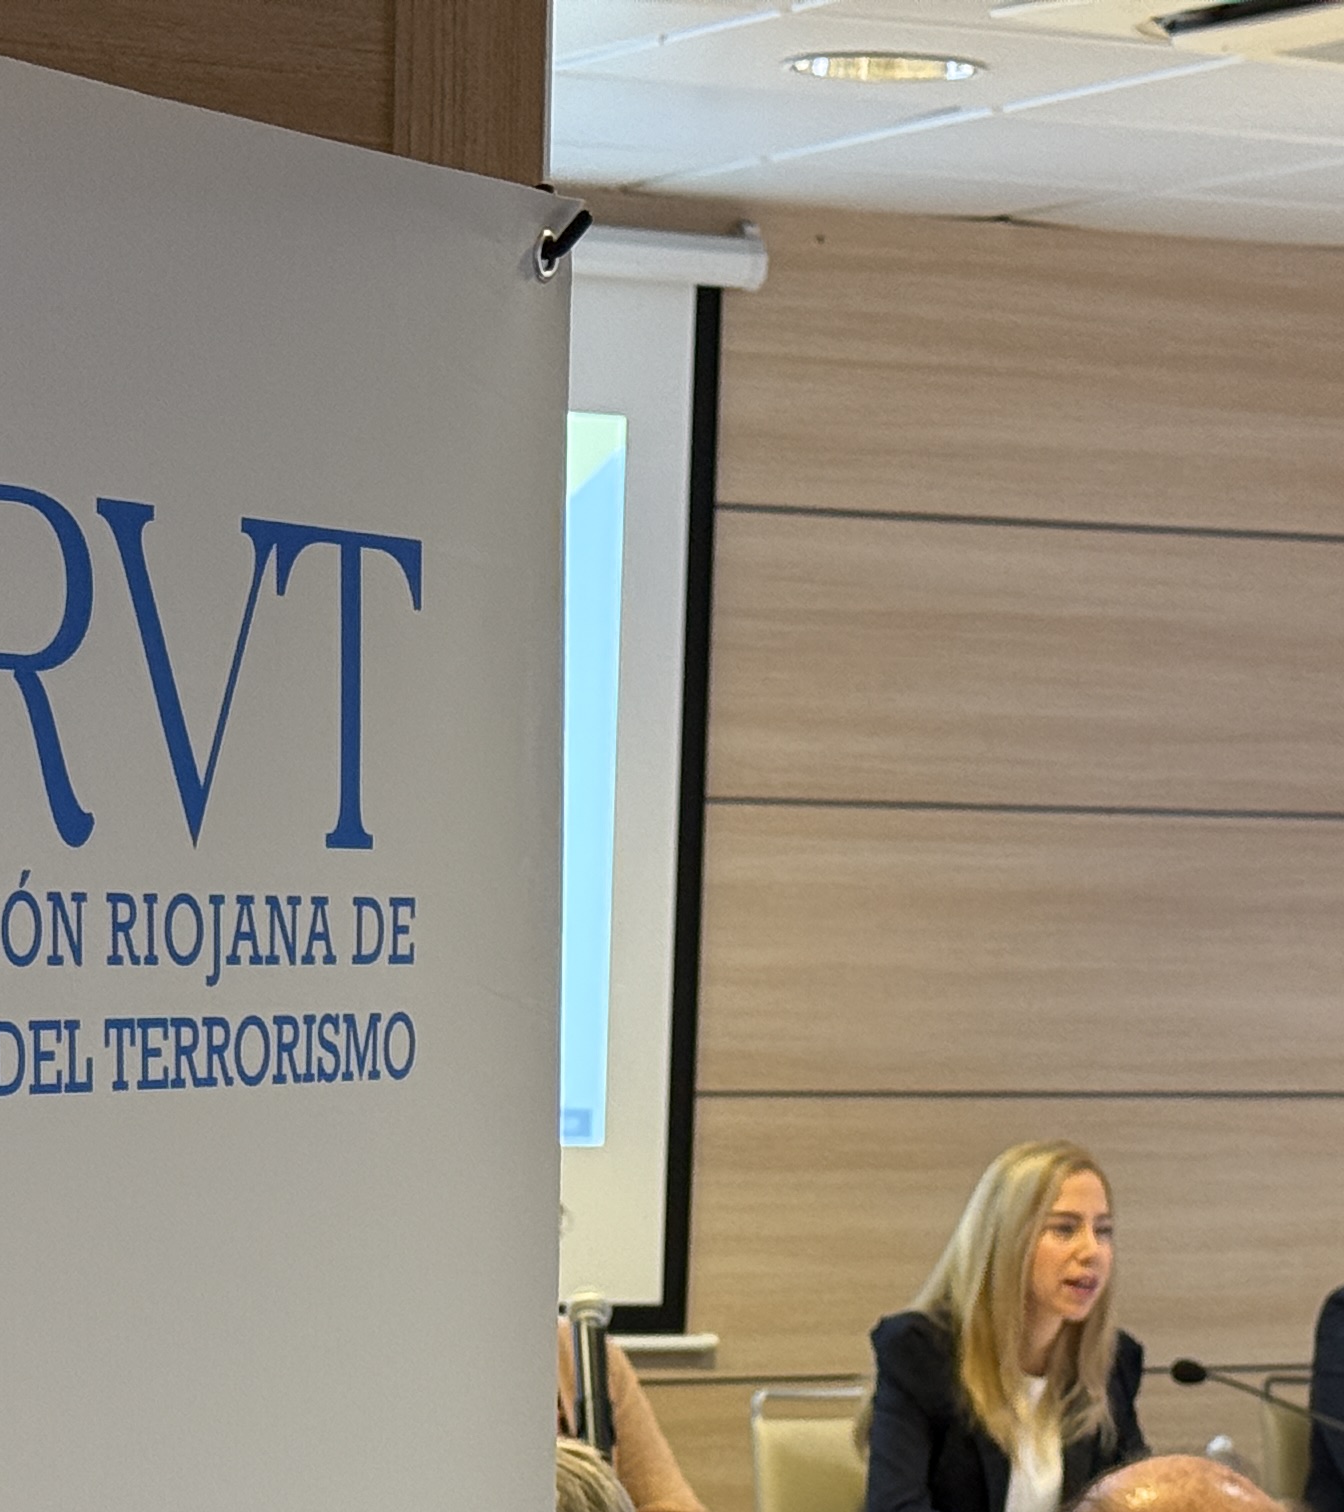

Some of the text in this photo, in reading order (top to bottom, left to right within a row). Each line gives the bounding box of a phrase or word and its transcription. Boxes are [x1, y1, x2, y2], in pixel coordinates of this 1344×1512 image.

[105, 892, 337, 987] RIOJANA
[351, 896, 416, 965] DE
[104, 1011, 416, 1092] TERRORISMO
